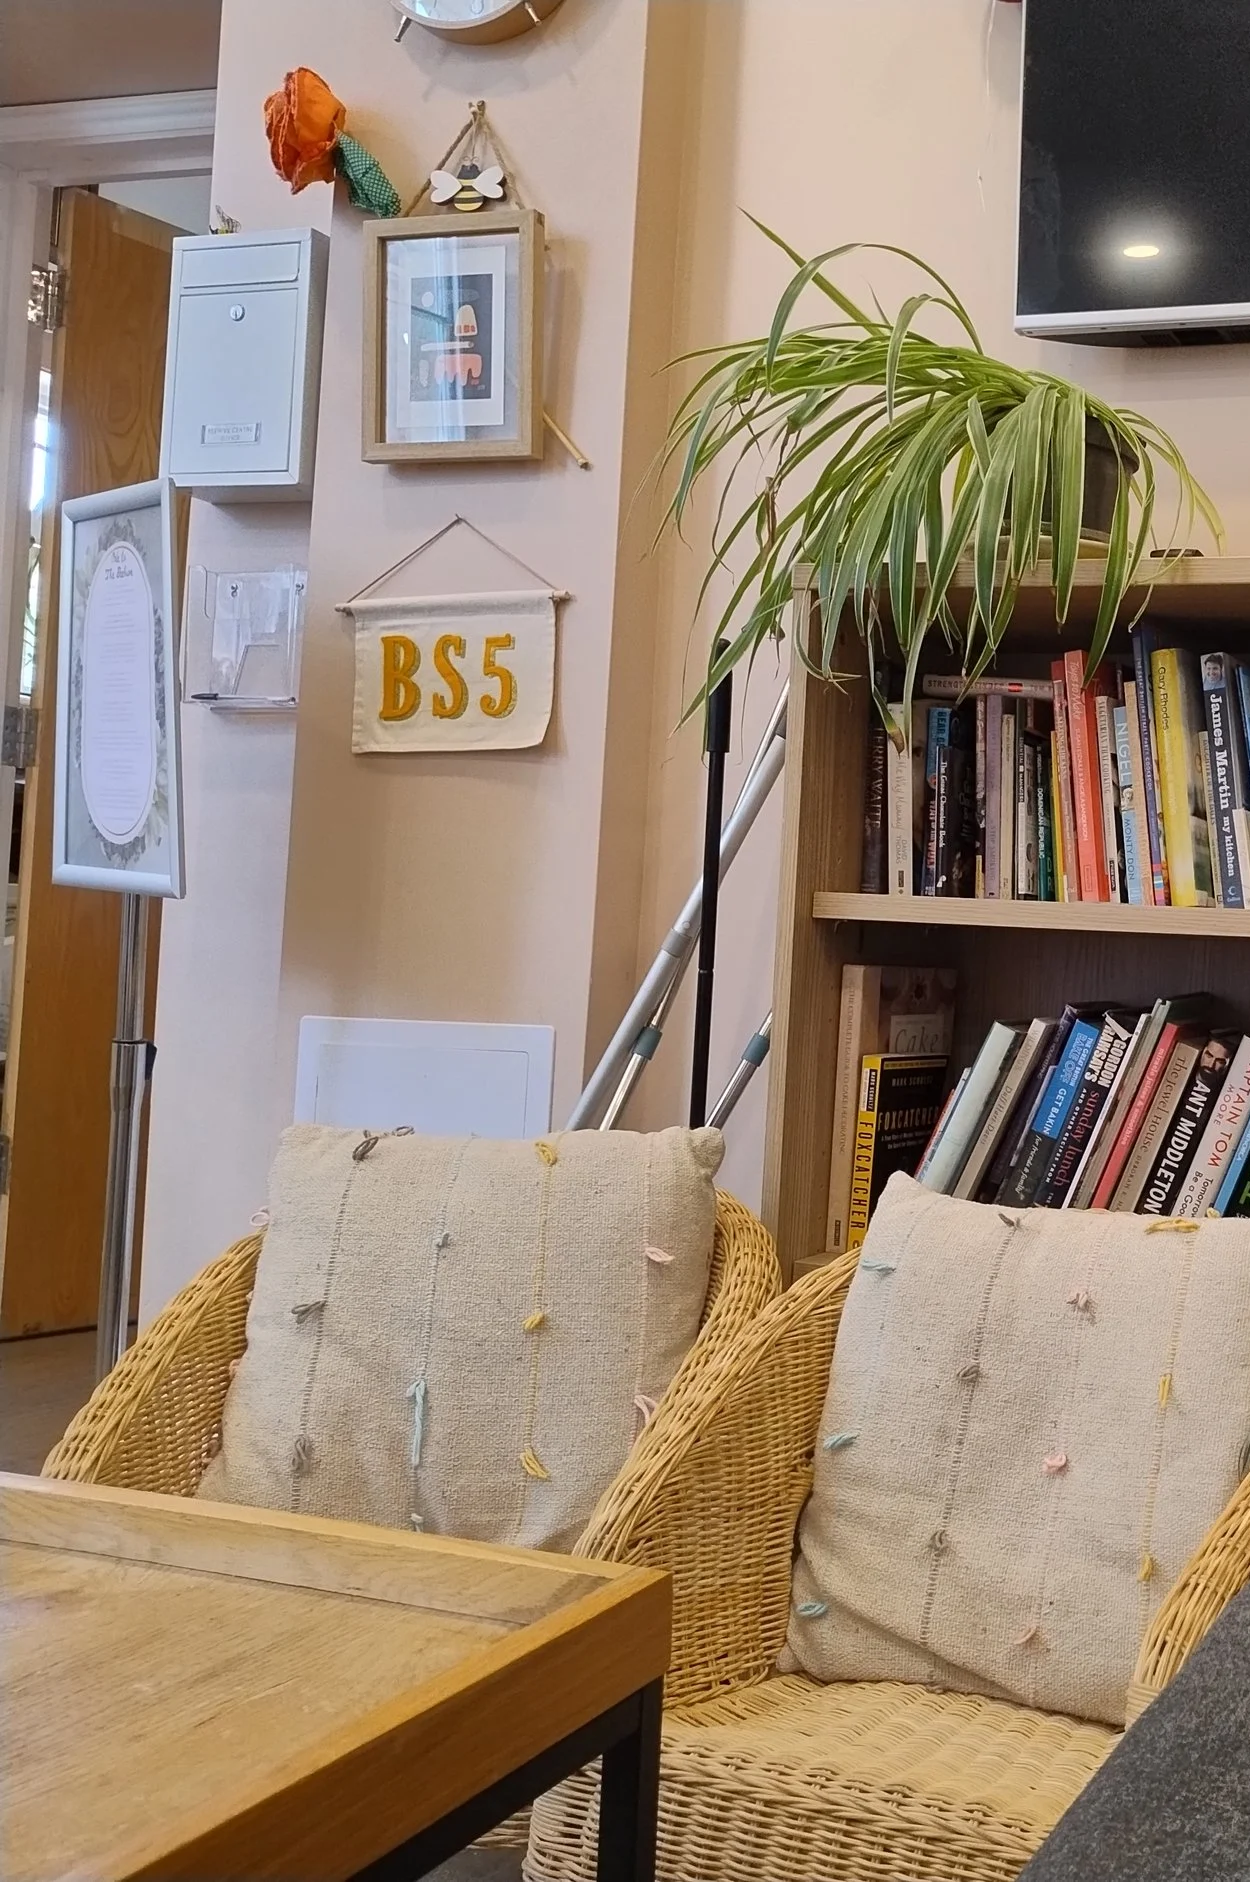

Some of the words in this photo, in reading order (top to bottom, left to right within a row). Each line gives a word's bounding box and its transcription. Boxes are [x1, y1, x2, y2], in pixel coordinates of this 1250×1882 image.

[379, 633, 518, 721] BS5
[1158, 666, 1168, 692] Gary
[1098, 700, 1107, 741] VEGETARIAN
[1161, 693, 1169, 730] Rhodes
[1209, 694, 1224, 746] James
[1116, 723, 1132, 783] NIGEL
[1102, 763, 1110, 794] COOKING
[1215, 750, 1230, 810] Martin
[870, 778, 882, 829] WAITE
[939, 795, 947, 830] Chocolate
[938, 831, 946, 848] Book
[1124, 818, 1133, 854] MONTY
[1223, 817, 1230, 834] my
[1127, 857, 1135, 881] DON
[1225, 835, 1235, 877] kitchen
[895, 1026, 939, 1053] Cake
[1067, 1032, 1088, 1059] BAKE
[1079, 1045, 1091, 1066] GREAT
[1084, 1025, 1116, 1083] RAMSAY'S
[1059, 1061, 1076, 1084] OFF
[1098, 1038, 1127, 1088] GORDON
[1170, 1054, 1187, 1081] The
[1057, 1088, 1067, 1107] GET
[1078, 1088, 1087, 1106] AND
[1157, 1080, 1177, 1113] Jewel
[1184, 1081, 1211, 1117] ANT
[1213, 1084, 1234, 1125] MOORE
[1066, 1106, 1081, 1131] OTHER
[1073, 1091, 1099, 1145] sunday
[1026, 1146, 1040, 1168] friends
[1033, 1135, 1042, 1147] for
[1053, 1132, 1070, 1162] RECIPES
[1208, 1133, 1233, 1167] TOM
[850, 1121, 874, 1229] FOXCATCHER
[1043, 1163, 1056, 1183] FROM
[1054, 1144, 1075, 1187] lunch
[1124, 1155, 1142, 1189] DEBORAH
[1143, 1117, 1196, 1214] MIDDLETON
[1192, 1171, 1203, 1184] Be
[1189, 1185, 1196, 1193] a
